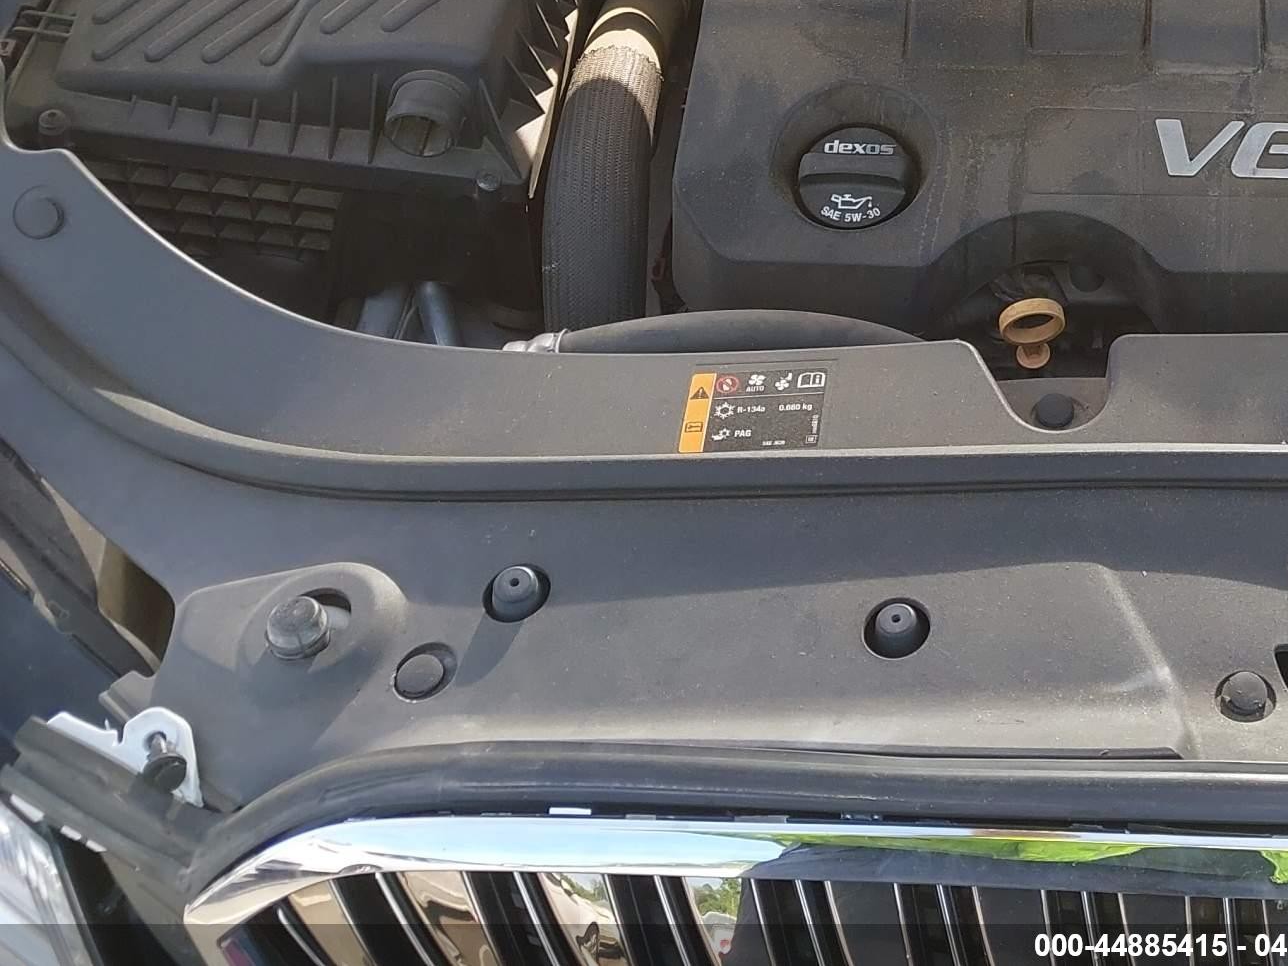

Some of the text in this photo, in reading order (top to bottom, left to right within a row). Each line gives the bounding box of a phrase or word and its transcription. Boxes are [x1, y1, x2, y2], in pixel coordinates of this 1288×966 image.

[823, 139, 897, 155] dexos
[820, 206, 881, 223] SAE 5W-30
[802, 402, 813, 412] kg
[734, 429, 752, 438] PAG
